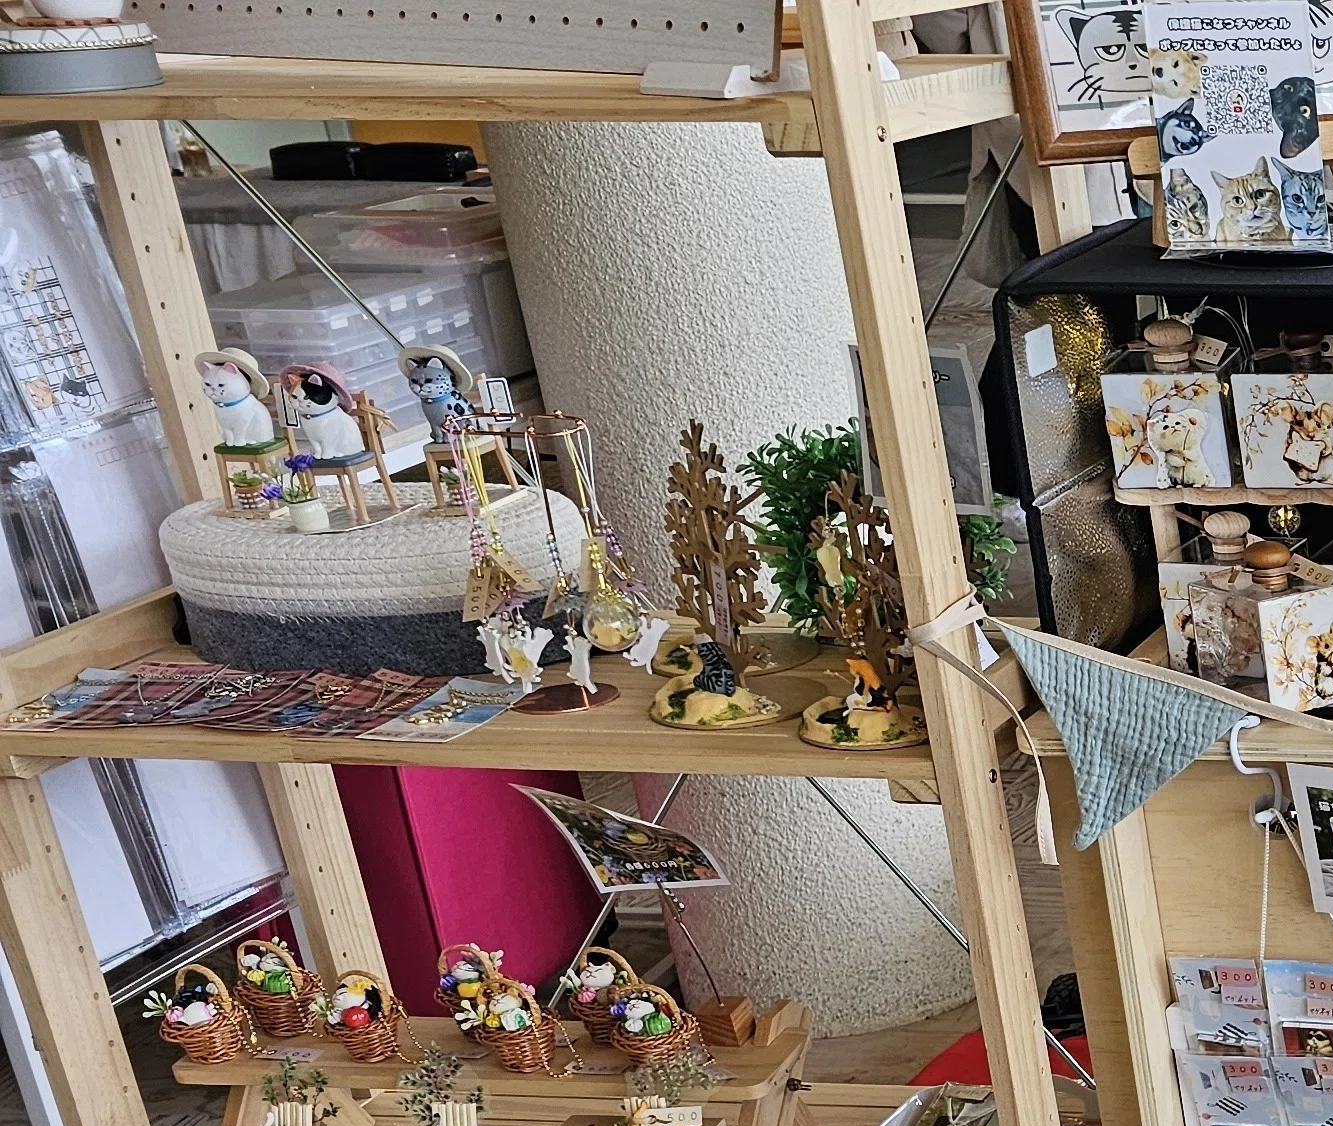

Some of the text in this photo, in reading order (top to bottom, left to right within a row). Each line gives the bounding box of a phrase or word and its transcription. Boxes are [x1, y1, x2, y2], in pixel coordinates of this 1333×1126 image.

[1220, 971, 1252, 982] 300
[1229, 1065, 1257, 1074] 300
[668, 1112, 697, 1123] 500
